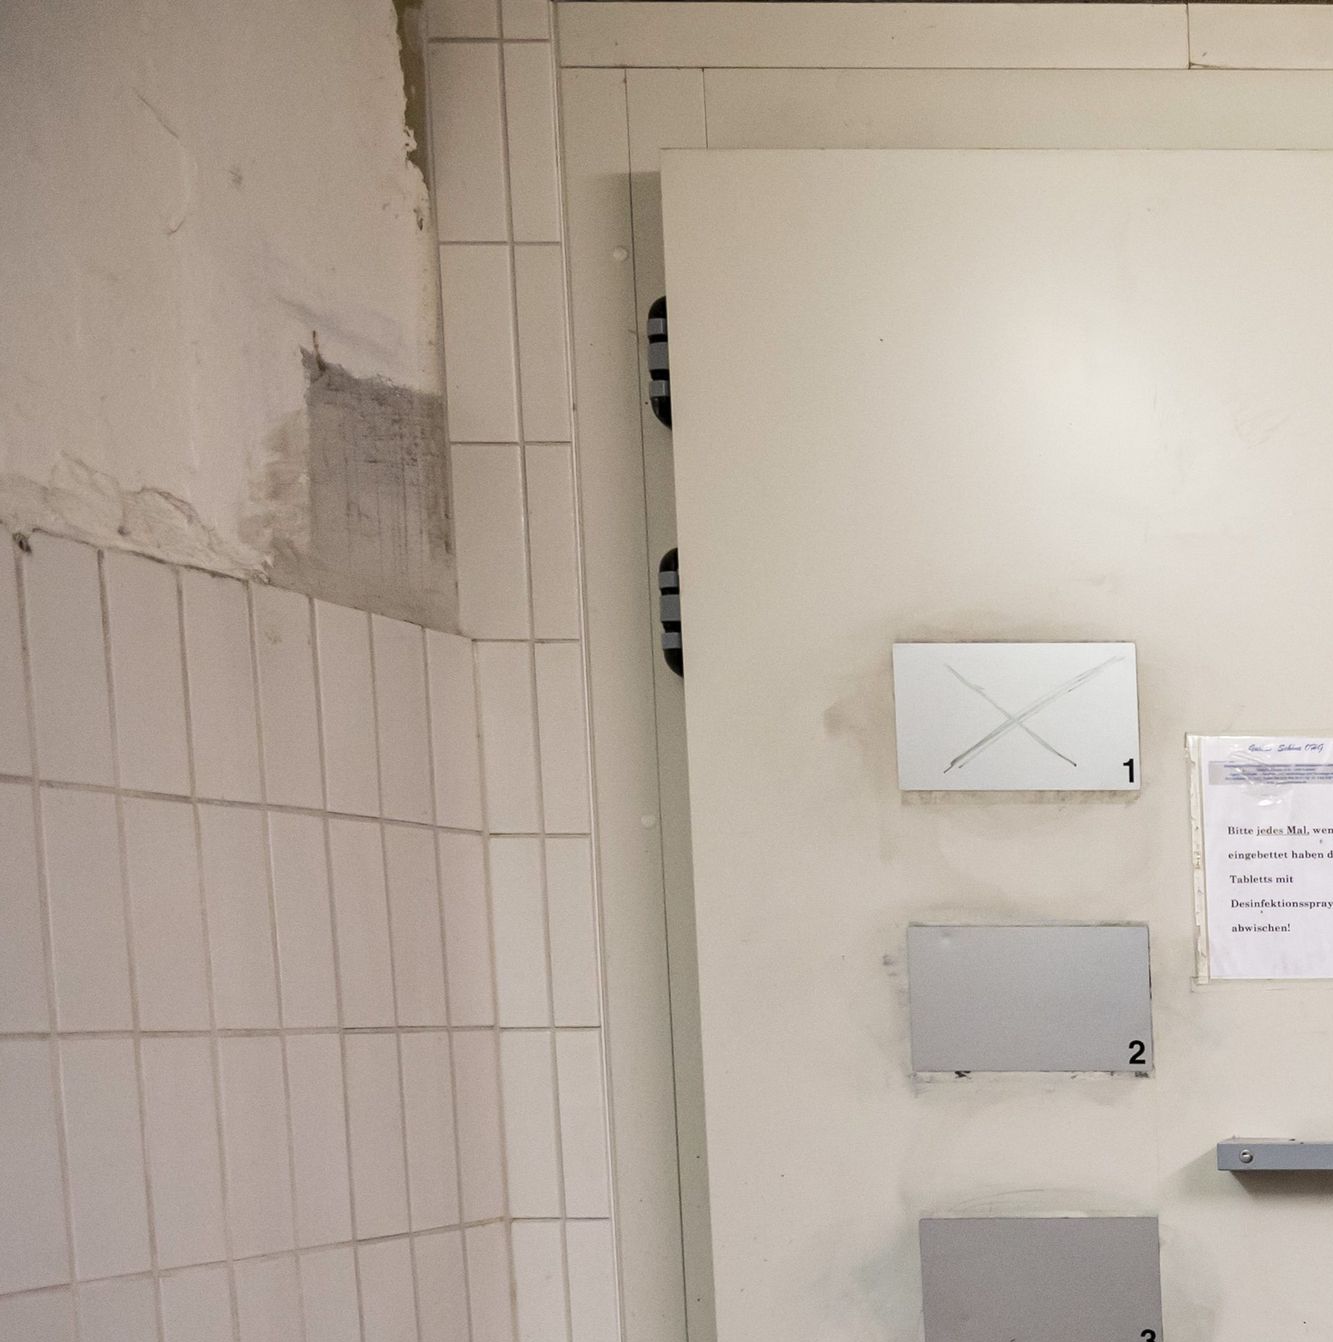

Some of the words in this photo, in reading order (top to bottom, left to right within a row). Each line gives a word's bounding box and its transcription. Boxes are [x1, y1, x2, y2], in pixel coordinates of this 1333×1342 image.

[1122, 758, 1135, 783] 1
[1228, 826, 1254, 835] Bitte
[1256, 826, 1284, 837] jedes
[1286, 826, 1310, 836] Mal,
[1228, 851, 1288, 860] eingebettet
[1291, 850, 1324, 859] haben
[1230, 875, 1273, 884] Tabletts
[1276, 875, 1293, 884] mit
[1230, 899, 1333, 909] Desinfektionsspray
[1231, 924, 1291, 932] abwischen!
[1128, 1039, 1146, 1065] 2
